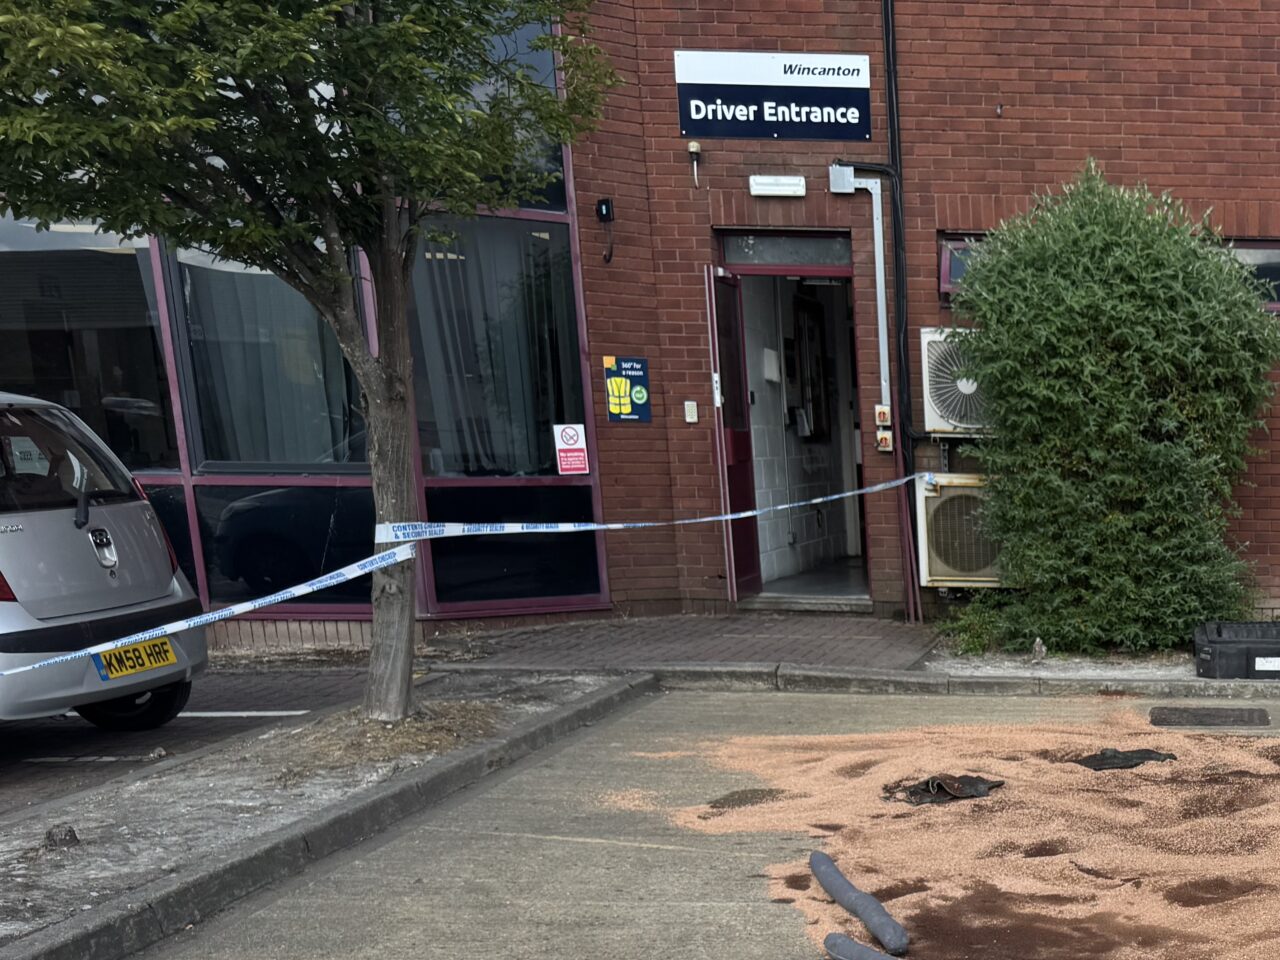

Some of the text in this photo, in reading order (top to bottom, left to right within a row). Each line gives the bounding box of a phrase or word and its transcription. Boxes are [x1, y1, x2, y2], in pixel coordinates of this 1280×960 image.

[783, 63, 861, 77] Wincanton
[690, 98, 860, 124] Driver Entrance
[103, 651, 146, 676] KM58
[145, 642, 171, 666] HRF
